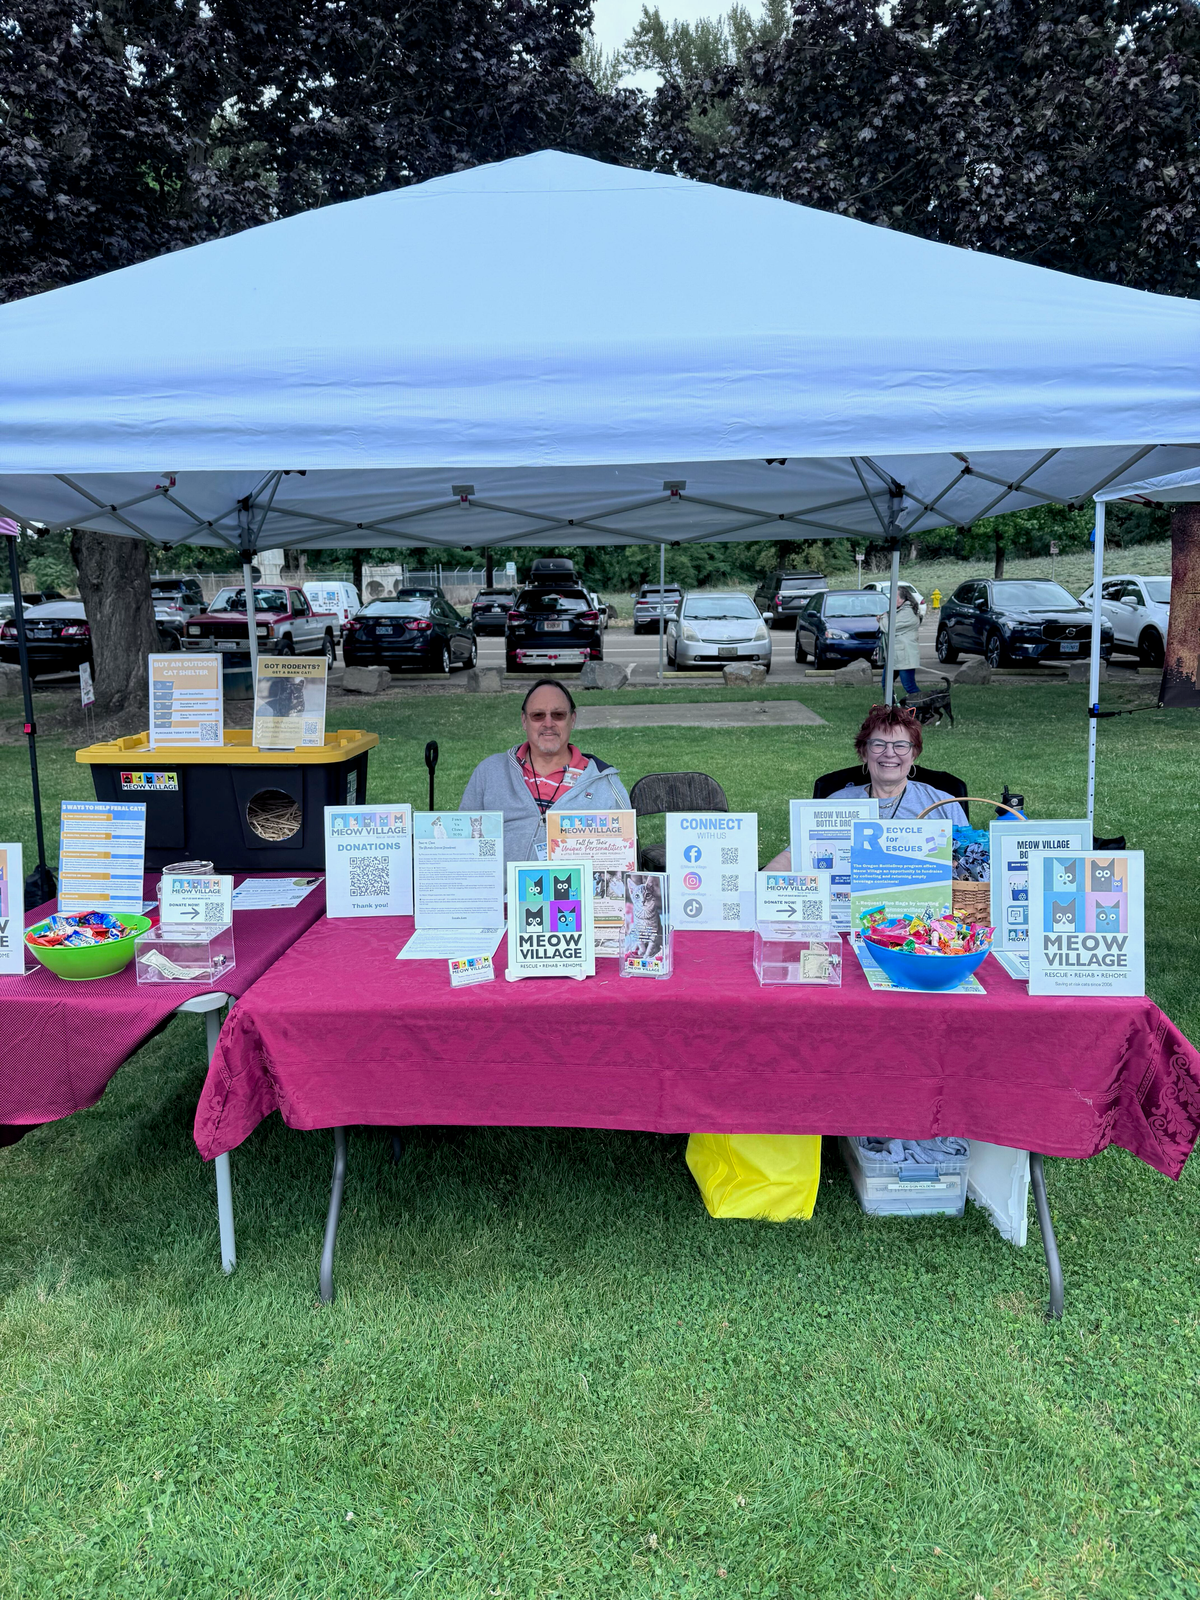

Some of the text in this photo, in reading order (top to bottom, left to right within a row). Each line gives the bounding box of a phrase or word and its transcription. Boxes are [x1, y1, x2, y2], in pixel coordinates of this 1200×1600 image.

[680, 818, 743, 830] CONNECT
[332, 826, 407, 836] MEOW VILLAGE
[338, 842, 401, 851] DONATIONS
[1017, 840, 1070, 849] MEOW VILLAGE
[519, 934, 582, 947] MEOW
[1043, 935, 1128, 951] MEOW
[520, 948, 582, 959] VILLAGE
[1044, 953, 1127, 967] VILLAGE
